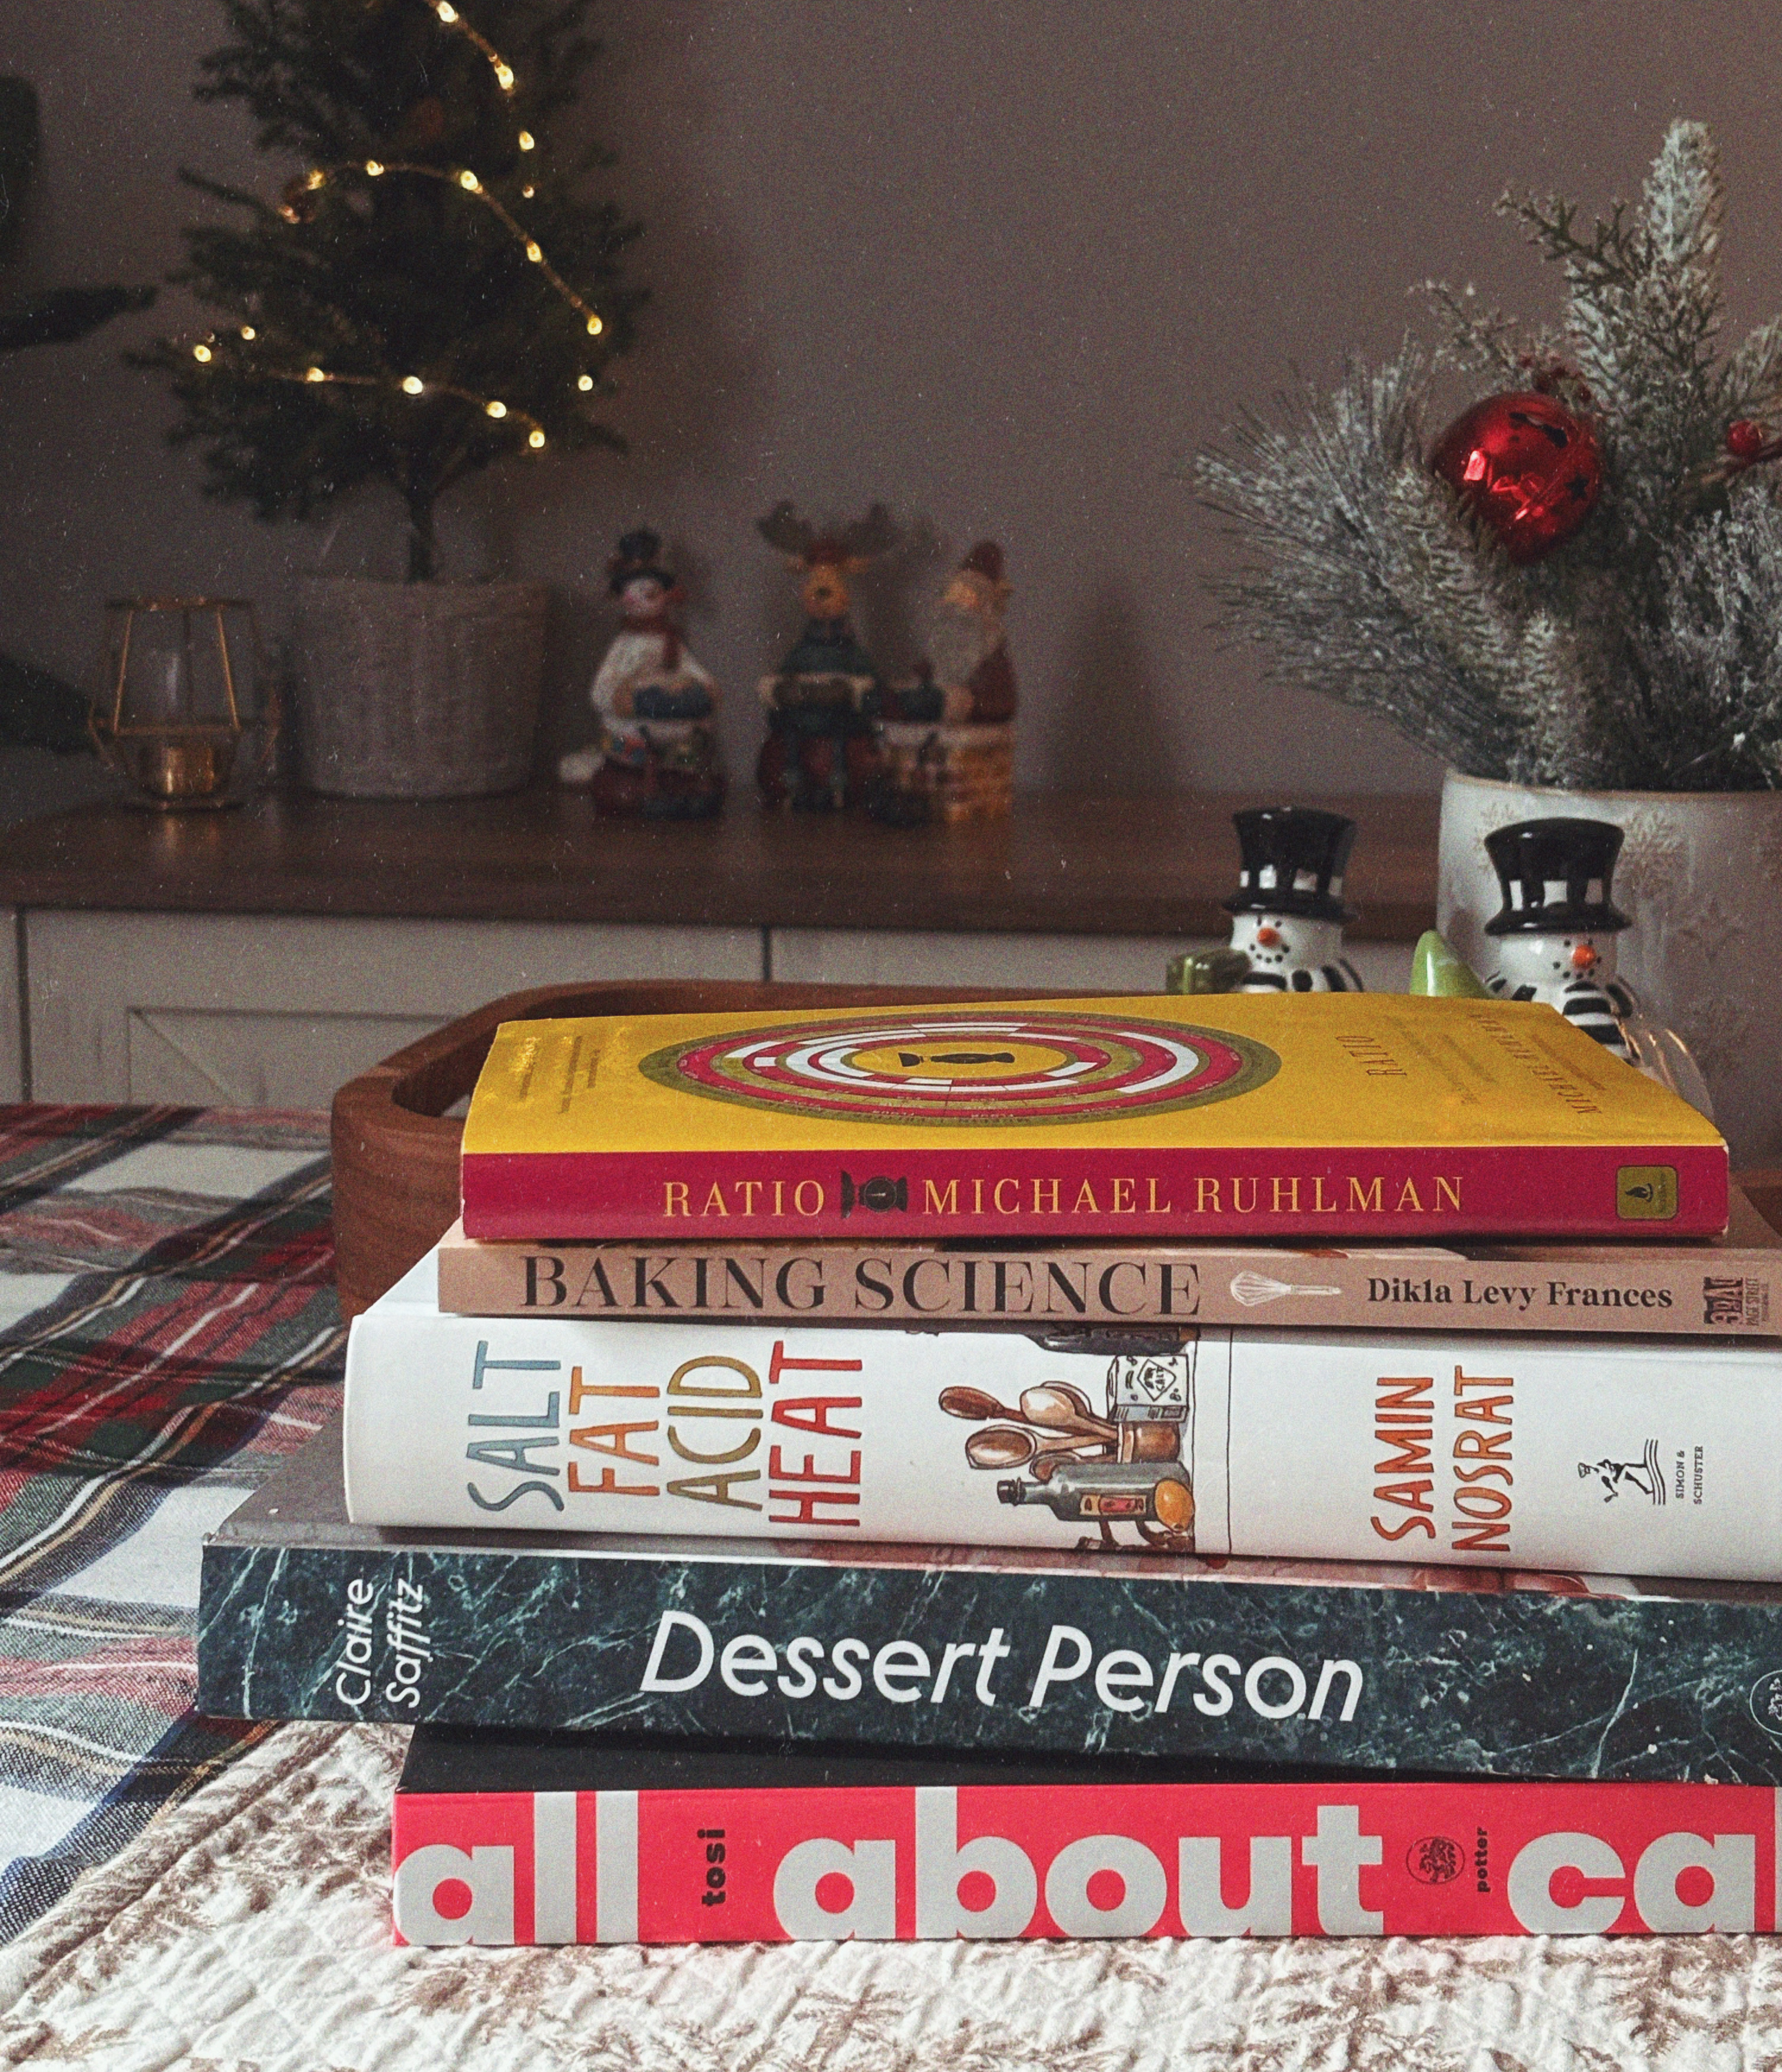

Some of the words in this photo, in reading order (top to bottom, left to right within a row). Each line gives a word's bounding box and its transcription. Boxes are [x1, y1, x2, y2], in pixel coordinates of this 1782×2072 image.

[1335, 1035, 1407, 1076] RATIO
[663, 1180, 825, 1218] RATIO
[923, 1178, 1172, 1215] MICHAEL
[1194, 1176, 1464, 1213] RUHLMAN
[520, 1256, 826, 1310] BAKING
[854, 1258, 1201, 1317] SCIENCE
[1367, 1278, 1452, 1304] Dikla
[1463, 1279, 1536, 1311] Levy
[1546, 1281, 1673, 1308] Frances
[466, 1340, 565, 1512] SALT
[567, 1366, 660, 1496] FAT
[667, 1355, 763, 1511] ACID
[768, 1341, 863, 1526] HEAT
[1370, 1377, 1437, 1542] SAMIN
[1451, 1365, 1514, 1552] NOSRAT
[1676, 1450, 1685, 1459] &
[1675, 1461, 1685, 1499] SIMON
[1693, 1446, 1703, 1505] SCHUSTER
[335, 1578, 374, 1705] Claire
[385, 1578, 434, 1708] Saffitz
[639, 1610, 1011, 1707] Dessert
[1029, 1625, 1364, 1722] Person
[393, 1790, 639, 1945] all
[773, 1785, 1384, 1938] about
[1507, 1786, 1782, 1934] ca
[697, 1829, 726, 1906] tosi
[1475, 1827, 1491, 1893] potter
